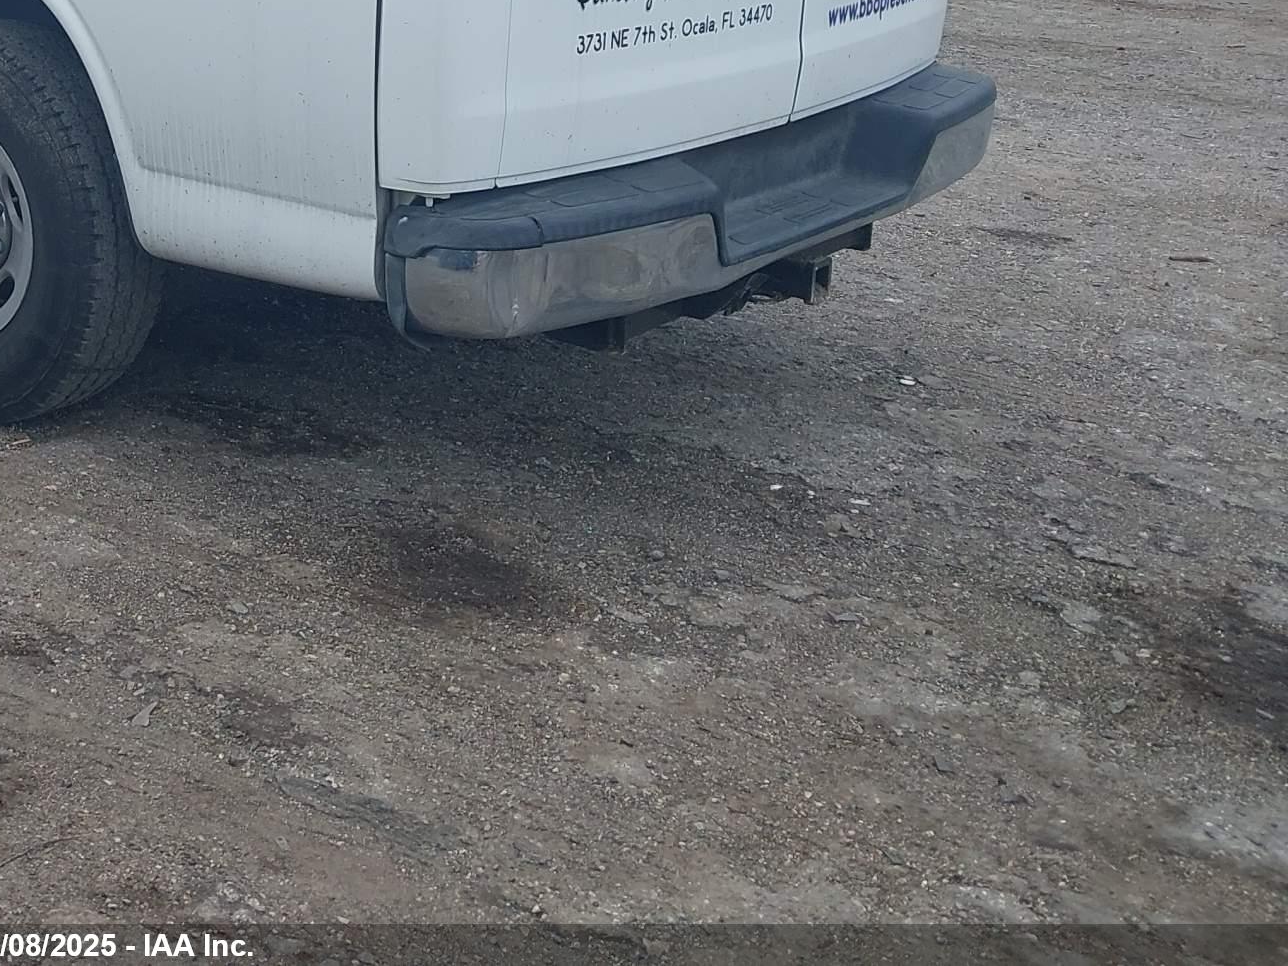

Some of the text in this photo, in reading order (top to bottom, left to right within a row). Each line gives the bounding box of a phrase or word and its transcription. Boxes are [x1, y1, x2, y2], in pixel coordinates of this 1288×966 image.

[576, 3, 773, 55] 3731 NE 7th St. Ocala, FL 34470
